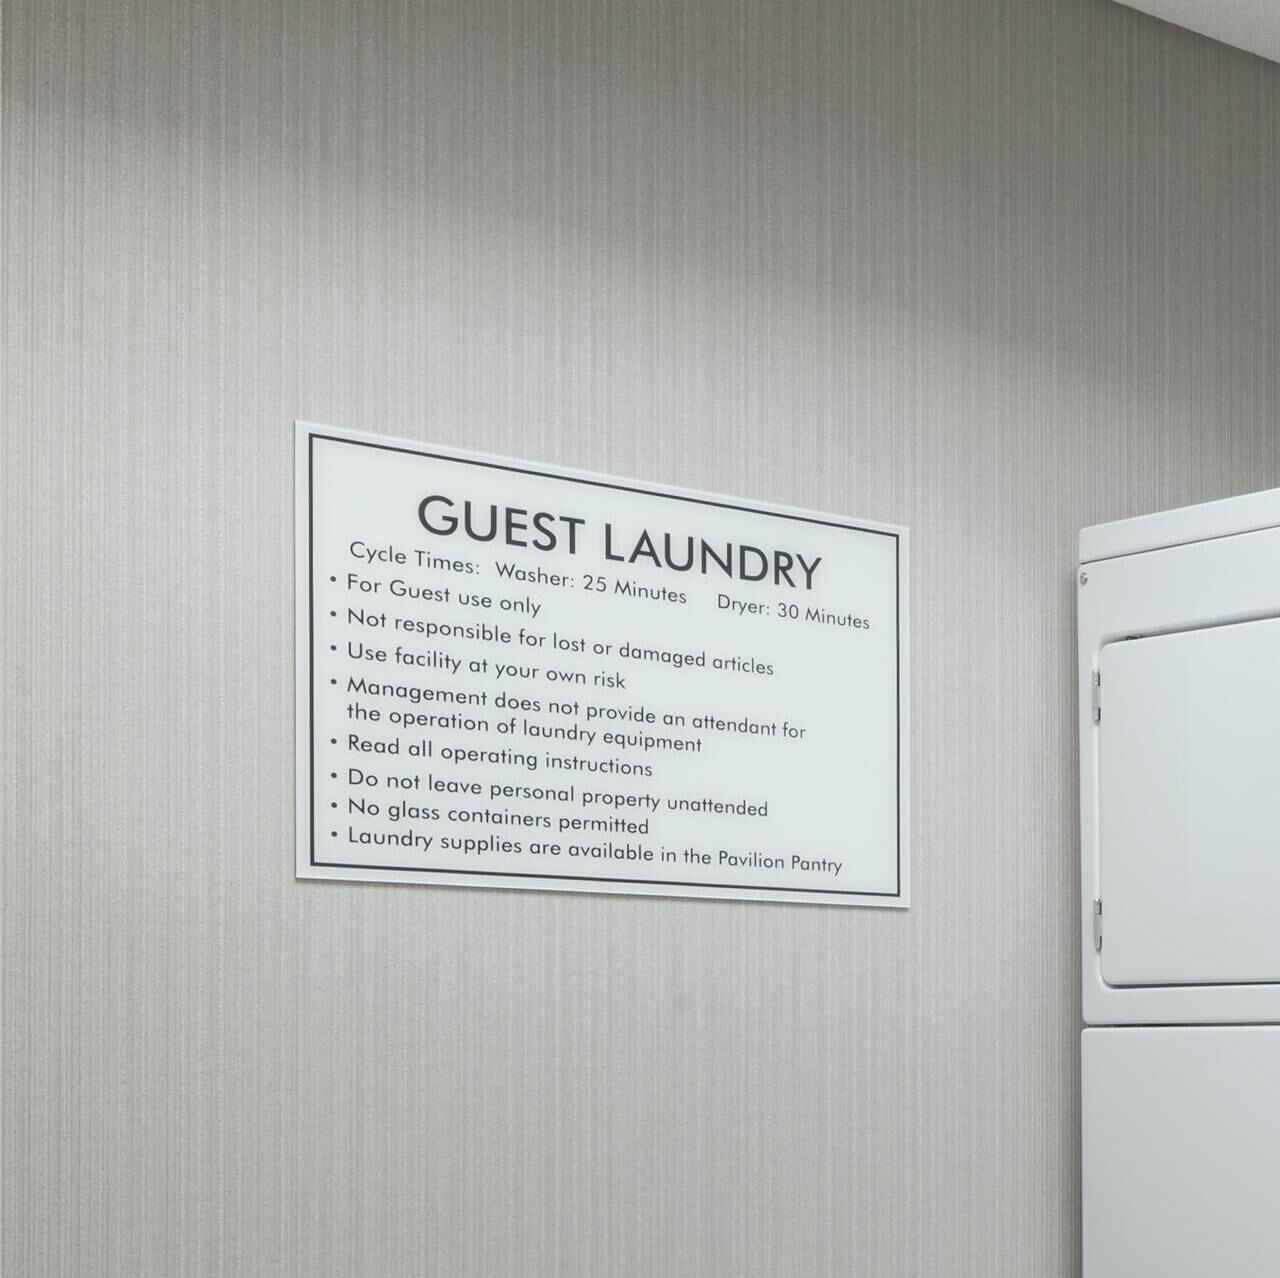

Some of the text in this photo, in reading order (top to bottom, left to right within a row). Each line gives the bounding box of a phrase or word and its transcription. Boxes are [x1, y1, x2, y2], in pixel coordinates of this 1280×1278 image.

[417, 494, 823, 591] GUEST LAUNDRY
[347, 572, 542, 619] For Guest use only
[349, 540, 871, 630] Cycle Times: Washer: 25 Minutes Dryer: 30 Minutes
[347, 607, 774, 676] Not responsible for lost or damaged articles
[347, 640, 627, 690] Use facility at your own risk
[346, 675, 807, 740] Management does not provide an attendant for
[346, 703, 703, 753] the operation of laundry equipment
[348, 733, 653, 777] Read all operating instructions
[348, 767, 768, 817] Do not leave personal property unattended
[348, 797, 649, 835] No glass containers permitted
[348, 825, 843, 877] Laundry supplies are available in the Pavilion Pantry
